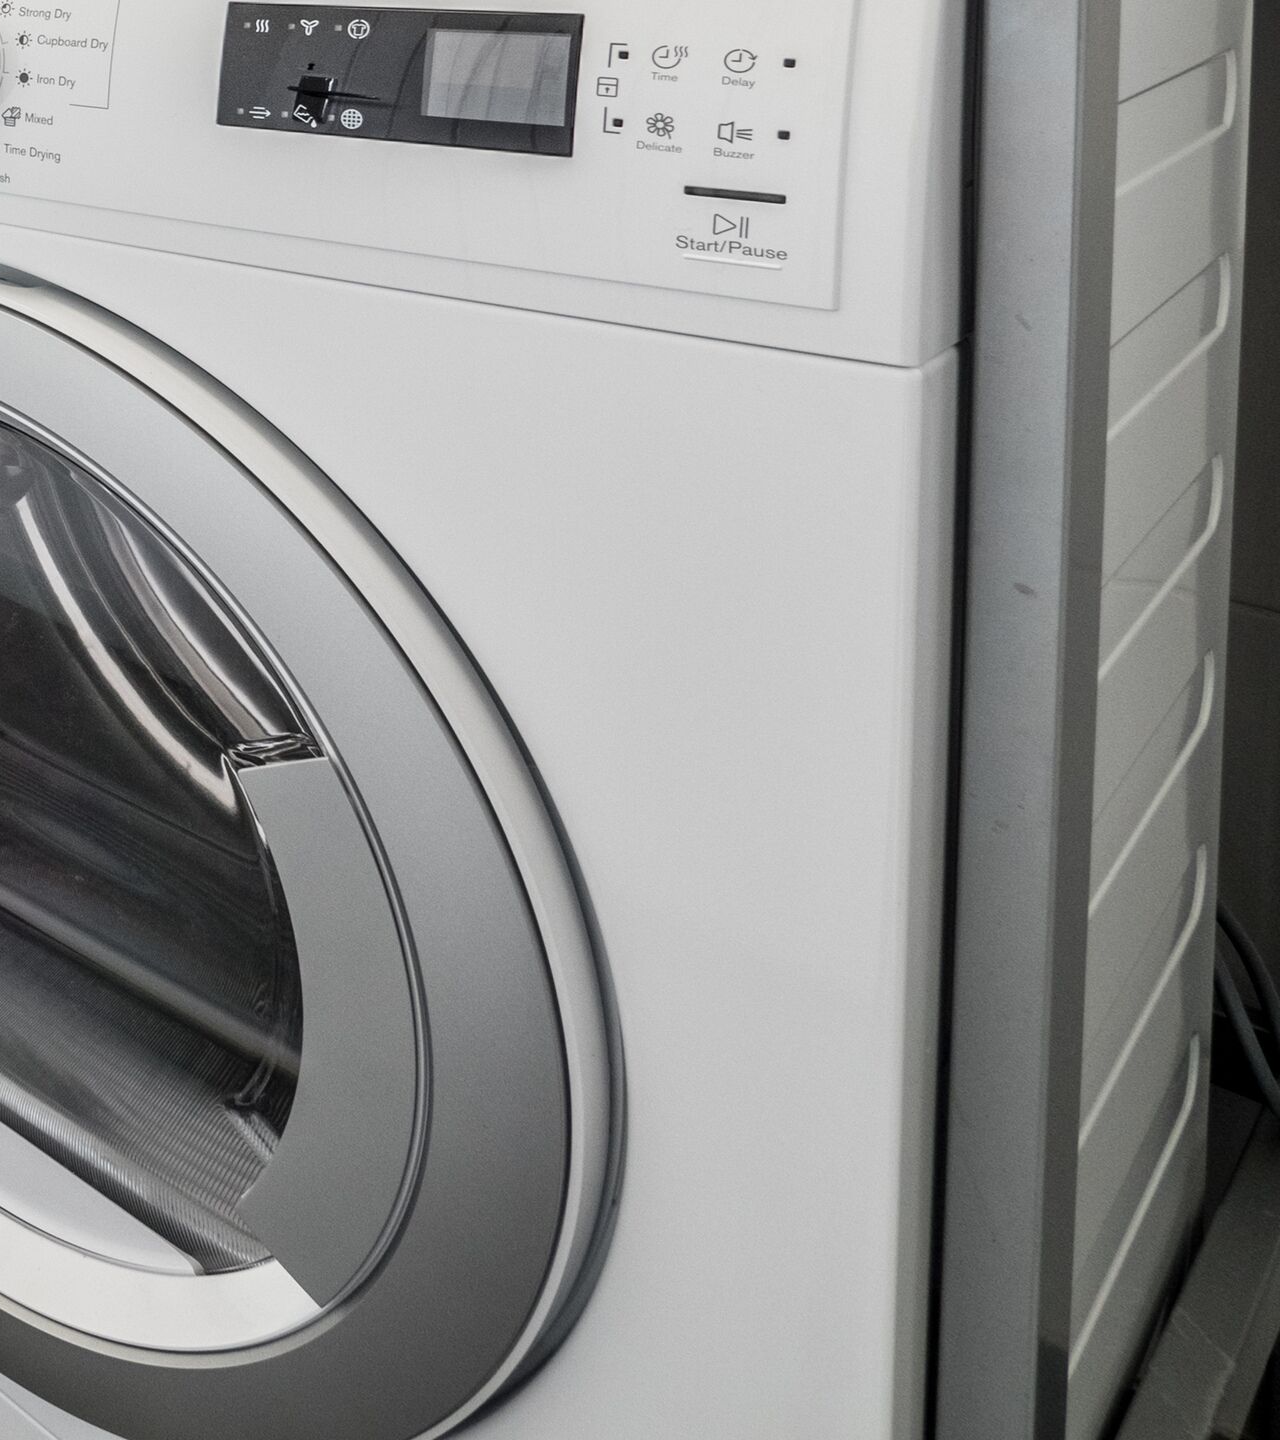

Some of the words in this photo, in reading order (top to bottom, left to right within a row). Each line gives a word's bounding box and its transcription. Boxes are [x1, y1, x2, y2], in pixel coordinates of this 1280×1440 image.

[19, 6, 51, 20] Strong
[54, 8, 71, 22] Dry
[37, 34, 88, 49] Cupboard
[90, 38, 108, 52] Dry
[36, 74, 55, 85] Iron
[58, 75, 76, 90] Dry
[651, 71, 679, 82] Time
[721, 76, 756, 90] Delay
[24, 112, 54, 126] Mixed
[4, 143, 27, 156] Time
[29, 146, 61, 164] Drying
[636, 140, 683, 154] Delicate
[713, 147, 755, 160] Buzzer
[675, 235, 788, 261] Start/Pause
